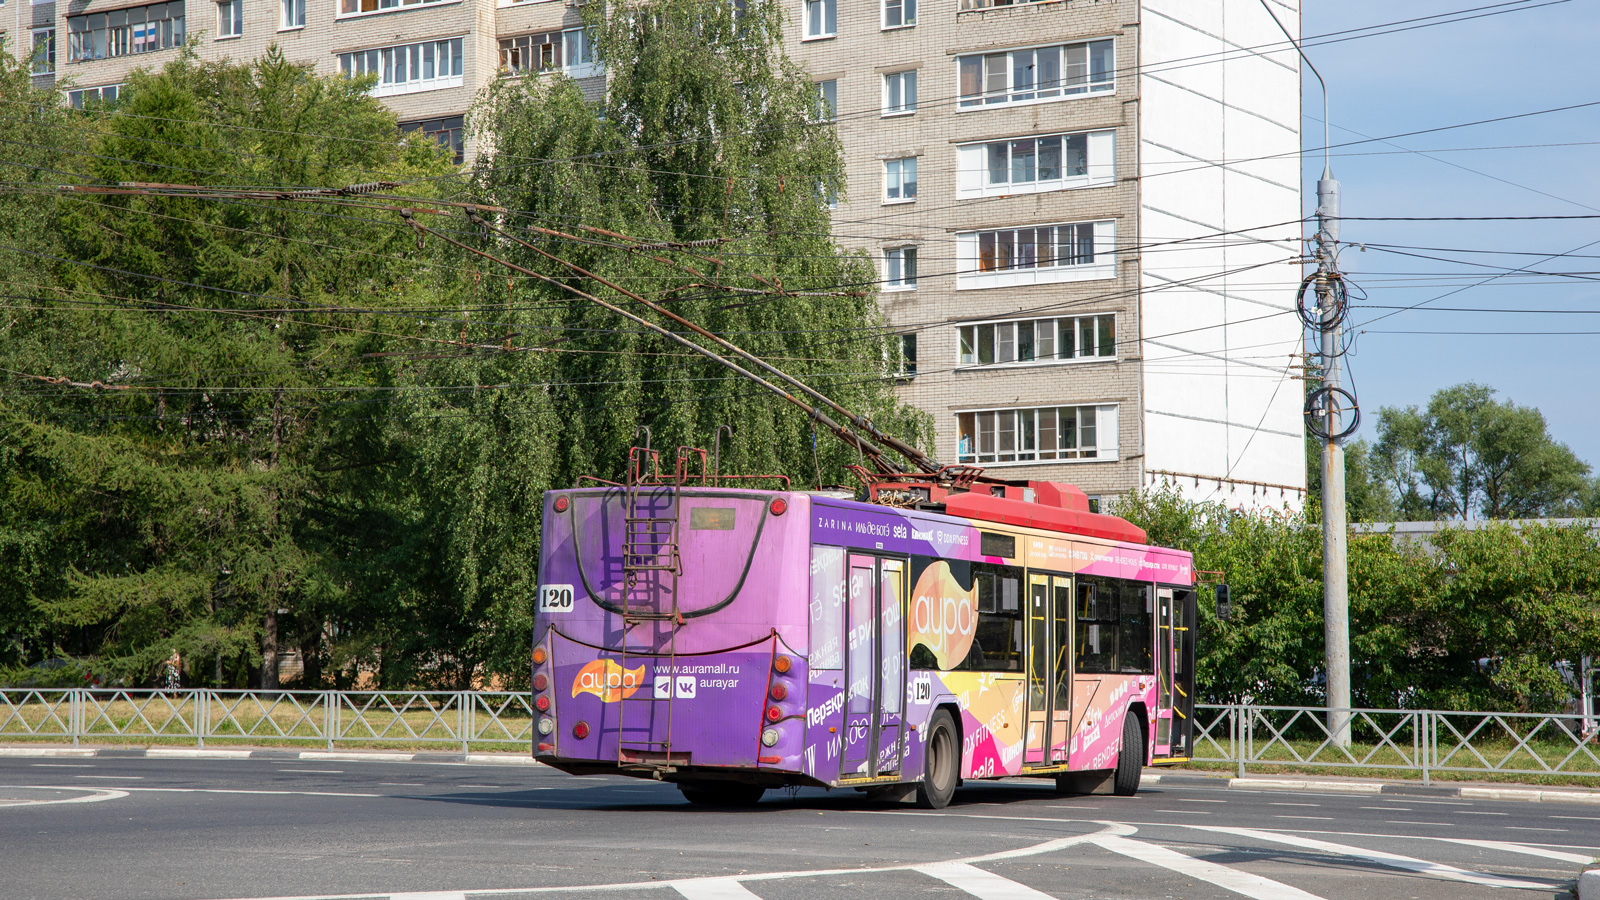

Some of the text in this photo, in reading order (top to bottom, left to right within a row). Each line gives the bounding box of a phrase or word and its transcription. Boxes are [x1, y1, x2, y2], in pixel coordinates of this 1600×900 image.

[818, 517, 853, 532] ZARINA
[893, 523, 907, 539] sela
[541, 588, 572, 608] 120
[653, 663, 740, 674] www.auramall.ru
[699, 678, 739, 691] aurayar
[916, 682, 931, 700] 120
